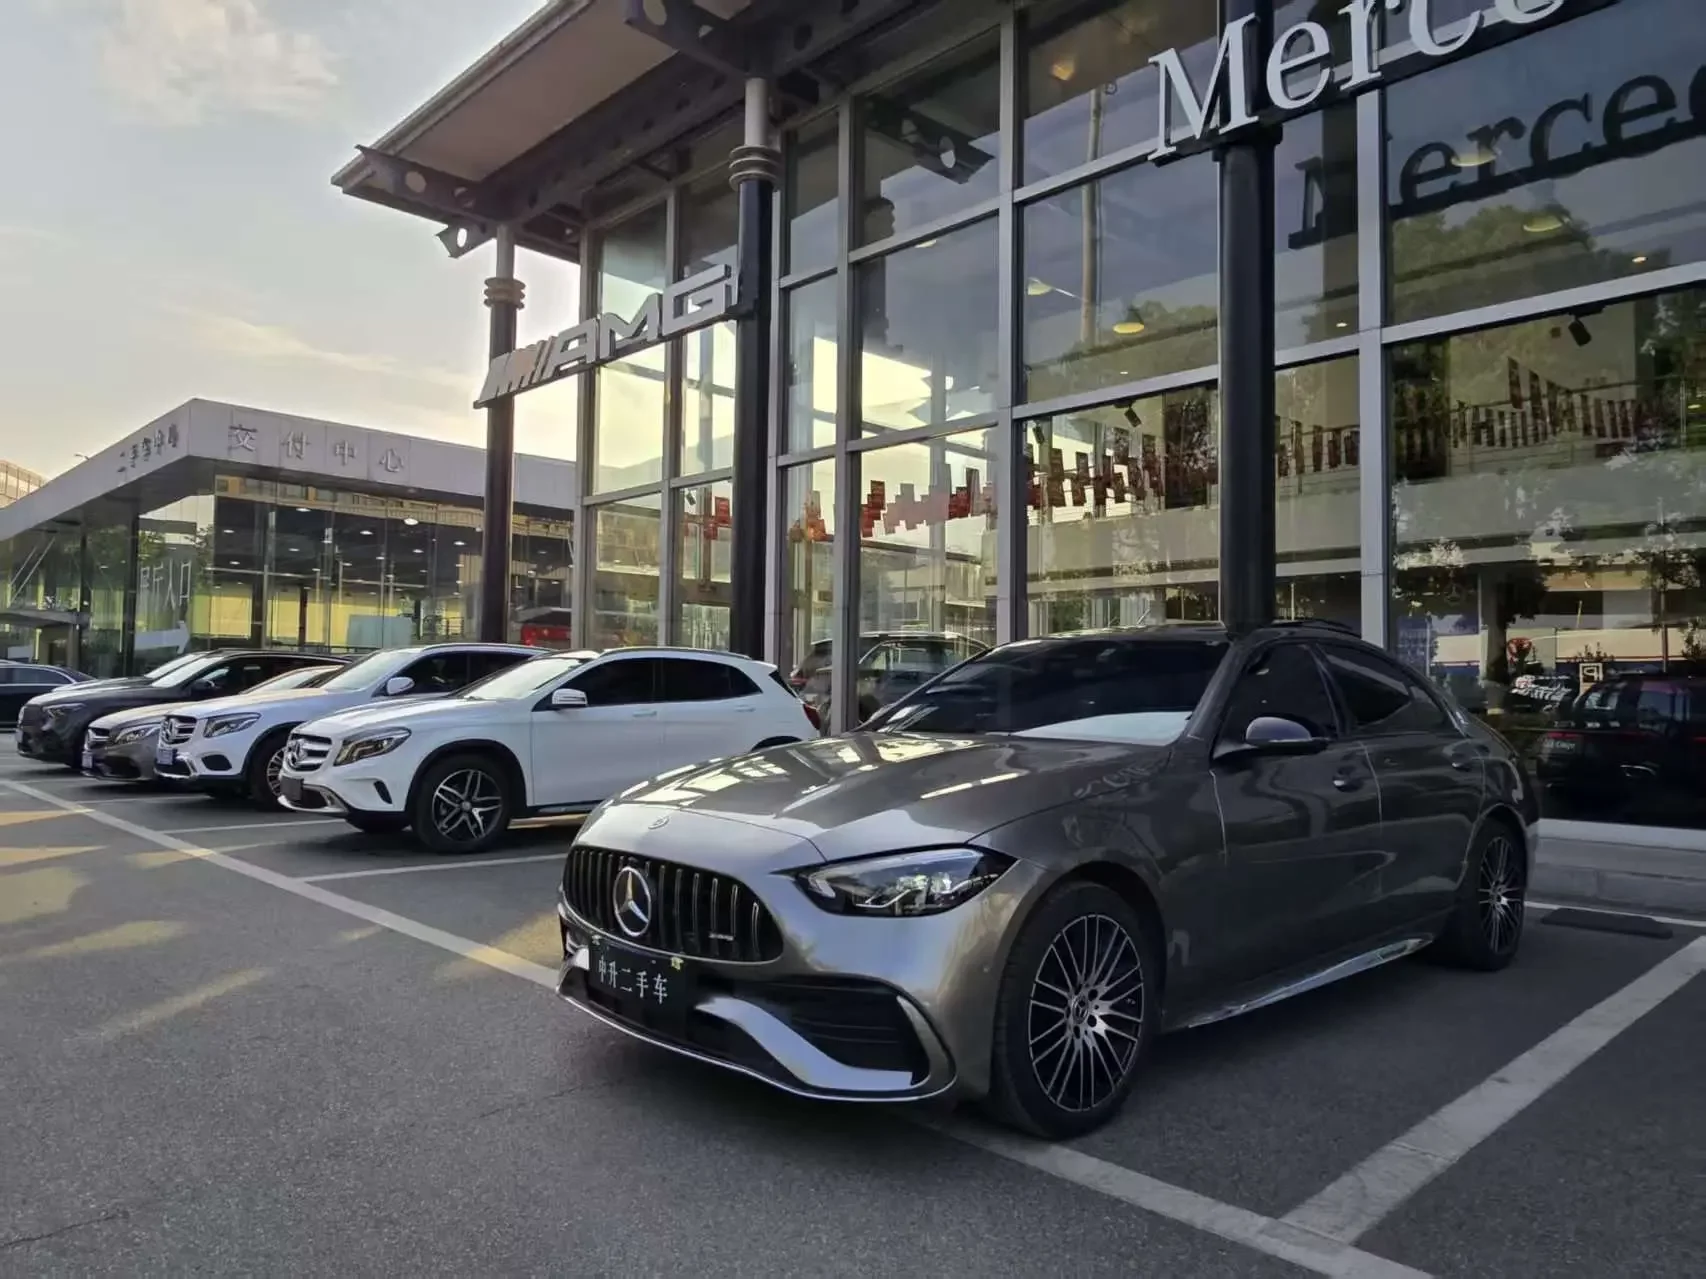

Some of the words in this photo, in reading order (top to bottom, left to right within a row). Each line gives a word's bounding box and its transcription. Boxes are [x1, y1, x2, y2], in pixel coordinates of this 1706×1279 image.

[1147, 0, 1563, 162] Merc
[228, 423, 405, 474] 交付中心
